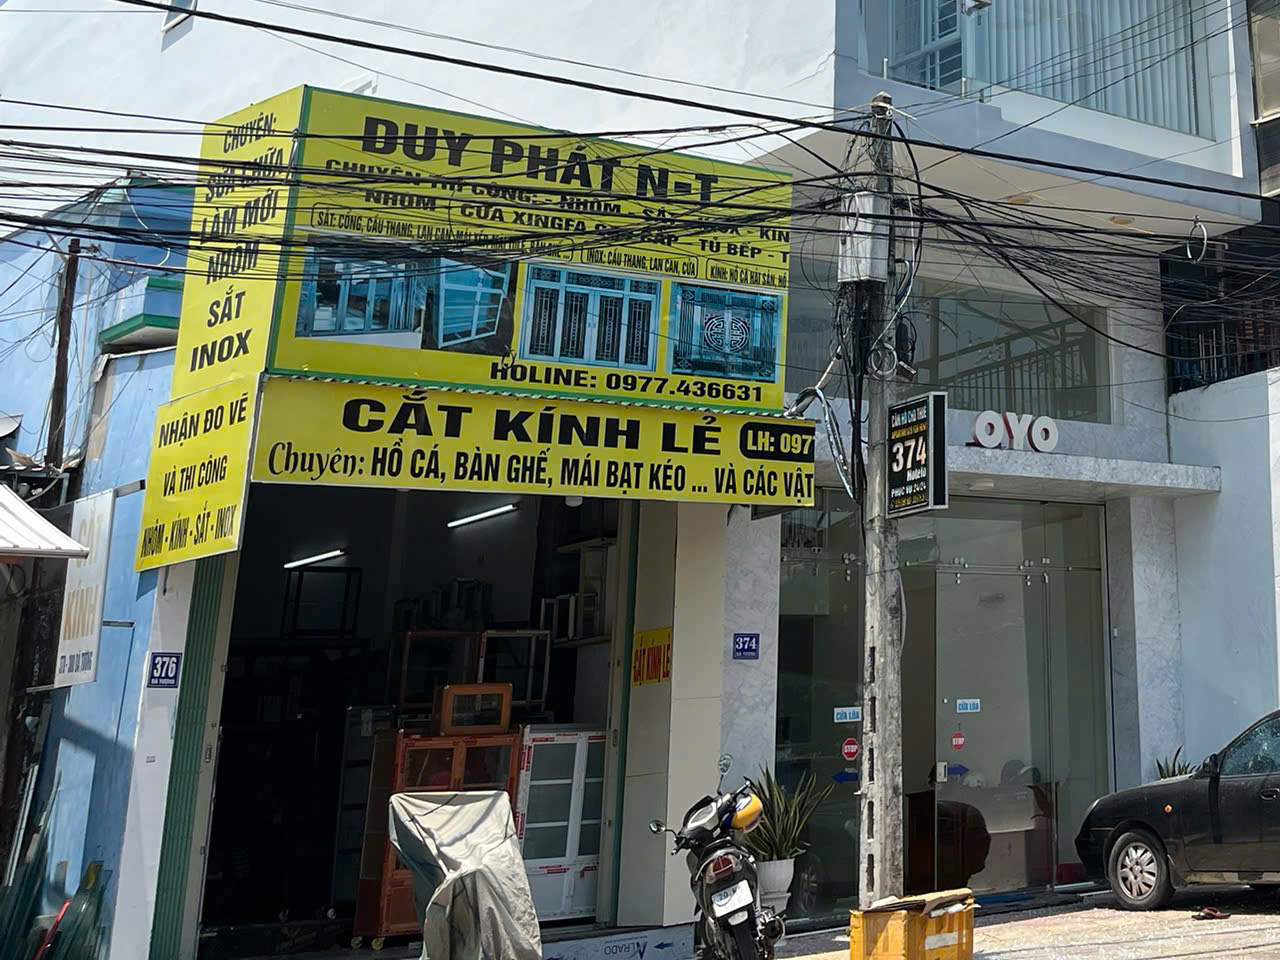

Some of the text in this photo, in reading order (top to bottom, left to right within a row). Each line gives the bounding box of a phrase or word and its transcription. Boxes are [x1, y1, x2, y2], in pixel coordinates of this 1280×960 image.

[362, 115, 474, 167] DUY
[490, 139, 622, 190] PHÁT
[512, 210, 588, 232] XINGFA
[699, 235, 721, 254] TỦ
[207, 285, 247, 328] SẮT
[190, 328, 251, 372] INOX
[490, 361, 763, 403] HOLINE: 0977.436631
[158, 392, 249, 448] NHẬN ĐO VẼ
[342, 389, 473, 438] CẮT
[493, 405, 641, 451] KÍNH
[661, 415, 722, 455] LẺ
[747, 429, 775, 452] LH:
[973, 409, 1060, 453] OYO
[163, 453, 228, 497] VÀ THI CÔNG
[268, 439, 365, 481] Chuyên:
[371, 437, 404, 477] HỒ
[410, 447, 446, 483] CÁ,
[454, 446, 499, 482] BÀN
[507, 447, 553, 488] GHẾ,
[560, 452, 600, 488] MÁI
[607, 459, 643, 495] BẠT
[650, 457, 686, 492] KÉO
[714, 461, 739, 495] VÀ
[743, 464, 778, 497] CÁC
[783, 467, 814, 503] VẬT
[891, 435, 927, 473] 374
[168, 513, 190, 552] KÍNH
[193, 501, 211, 545] SẮT
[214, 504, 238, 540] INOX
[735, 636, 757, 650] 374
[153, 656, 177, 678] 376
[844, 744, 858, 754] STOP
